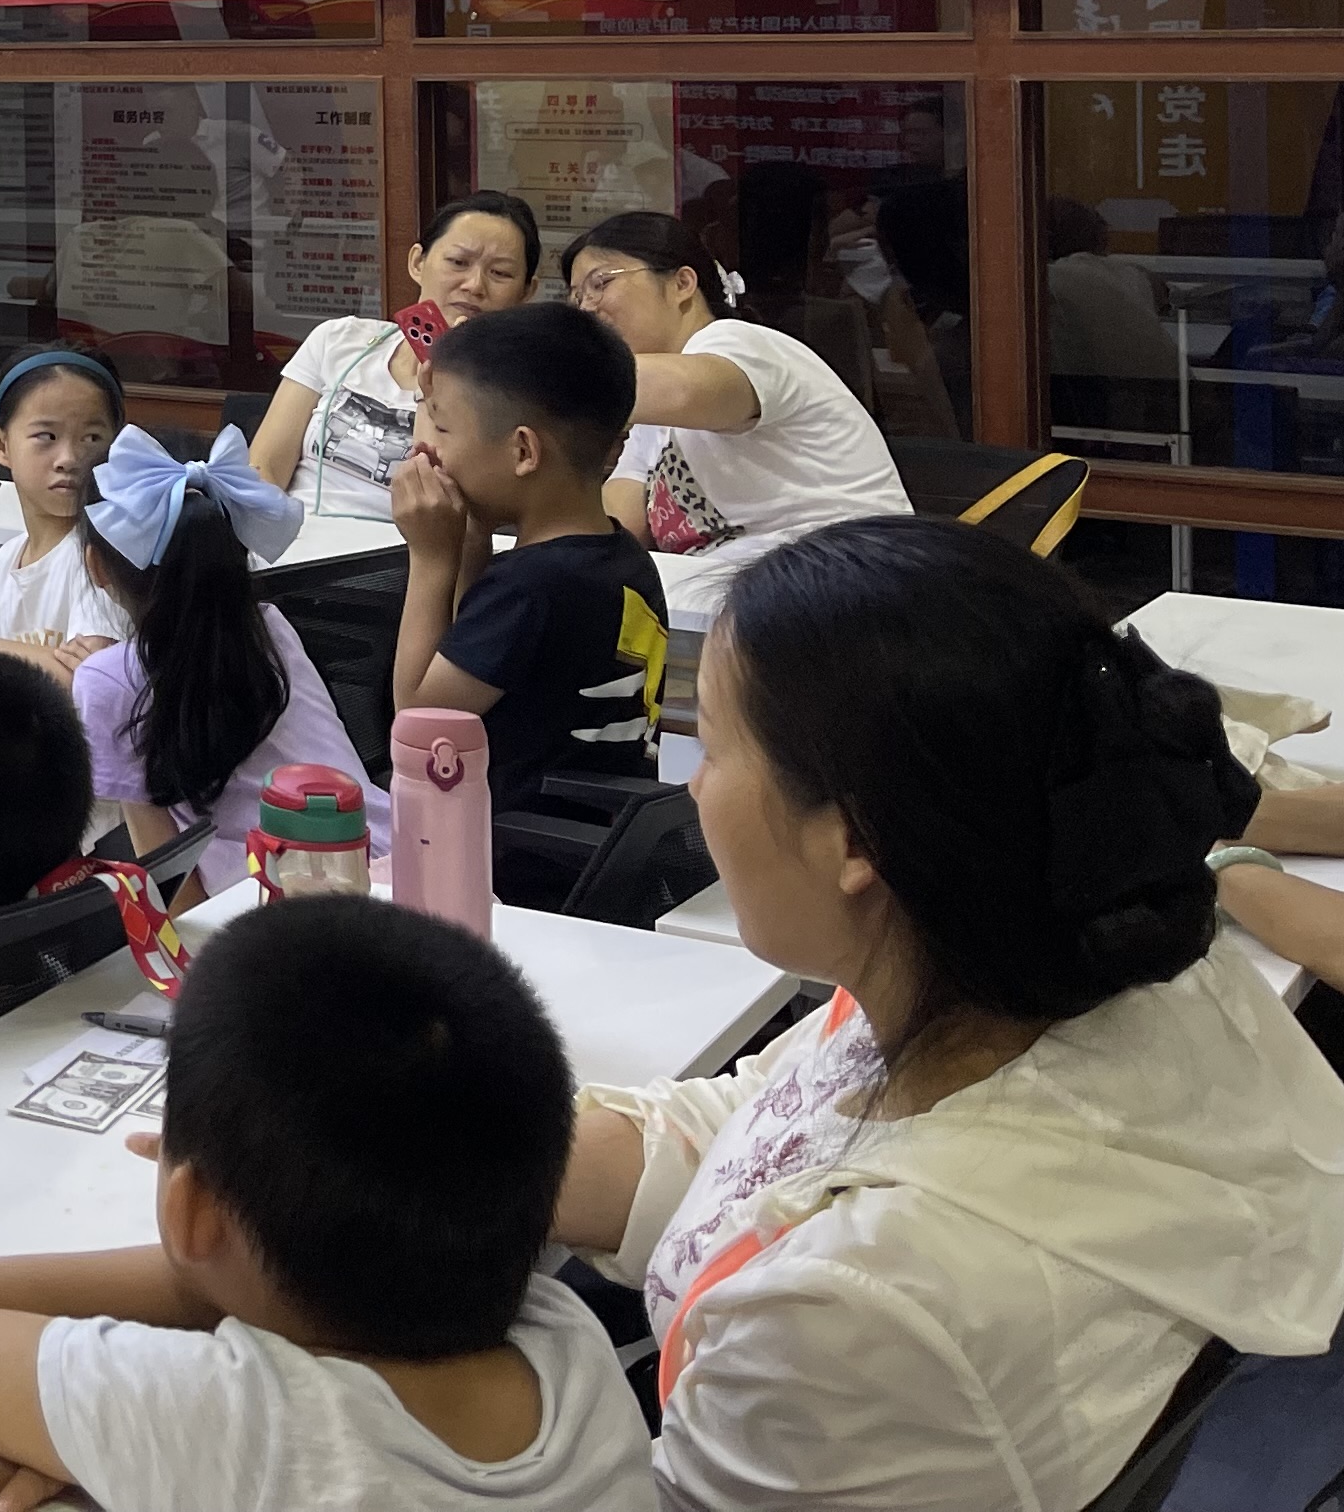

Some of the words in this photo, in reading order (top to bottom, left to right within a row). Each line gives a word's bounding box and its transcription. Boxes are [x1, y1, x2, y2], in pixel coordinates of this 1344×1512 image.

[112, 109, 165, 125] 服务内容
[314, 110, 373, 126] 工作制度
[548, 161, 599, 175] 五关爱
